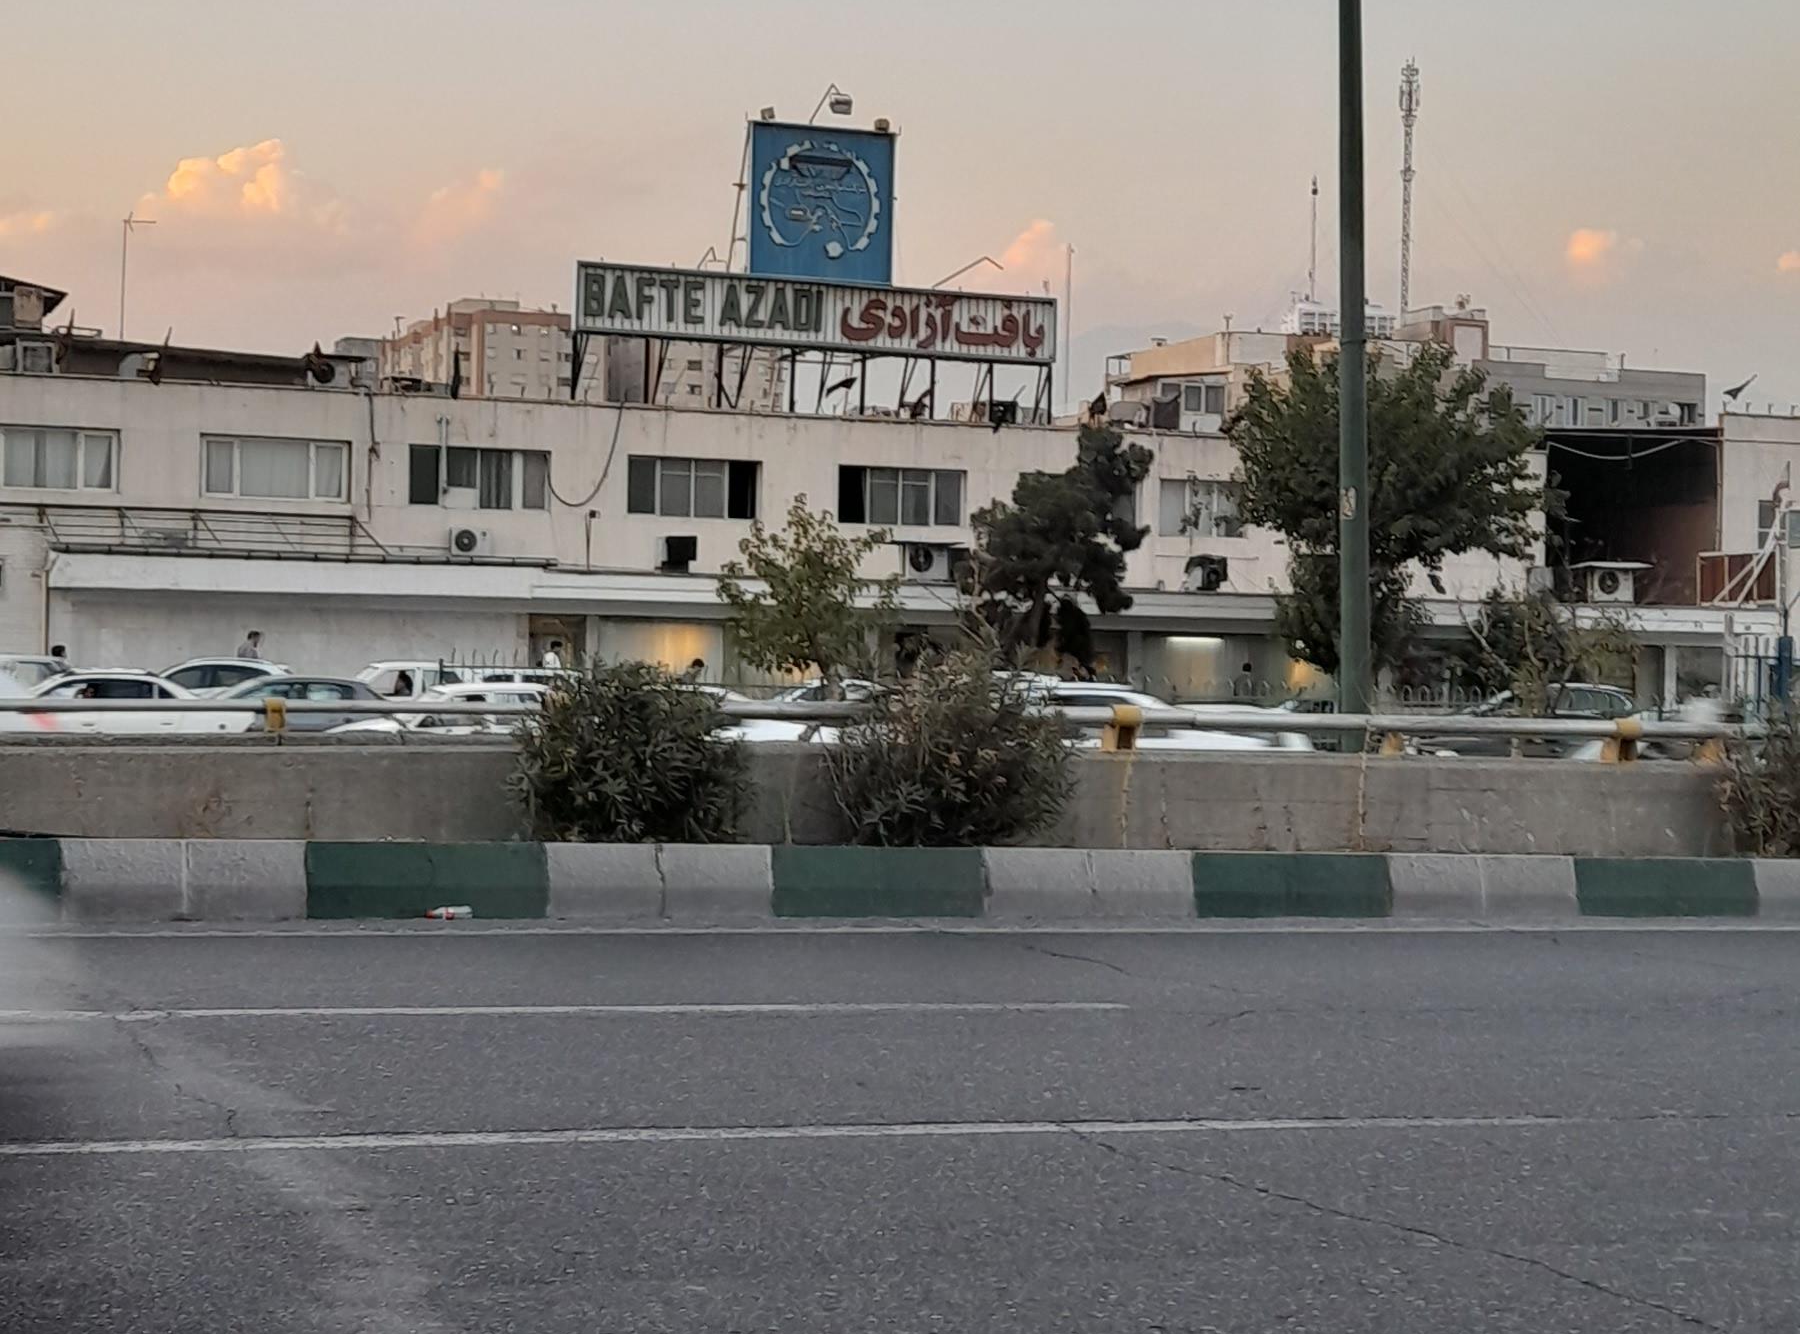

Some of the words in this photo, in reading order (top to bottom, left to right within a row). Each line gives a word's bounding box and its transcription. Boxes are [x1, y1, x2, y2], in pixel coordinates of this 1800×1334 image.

[583, 273, 706, 324] BAFTE
[719, 285, 823, 332] AZADI
[841, 295, 955, 349] آزادی
[955, 303, 1045, 357] بافت
